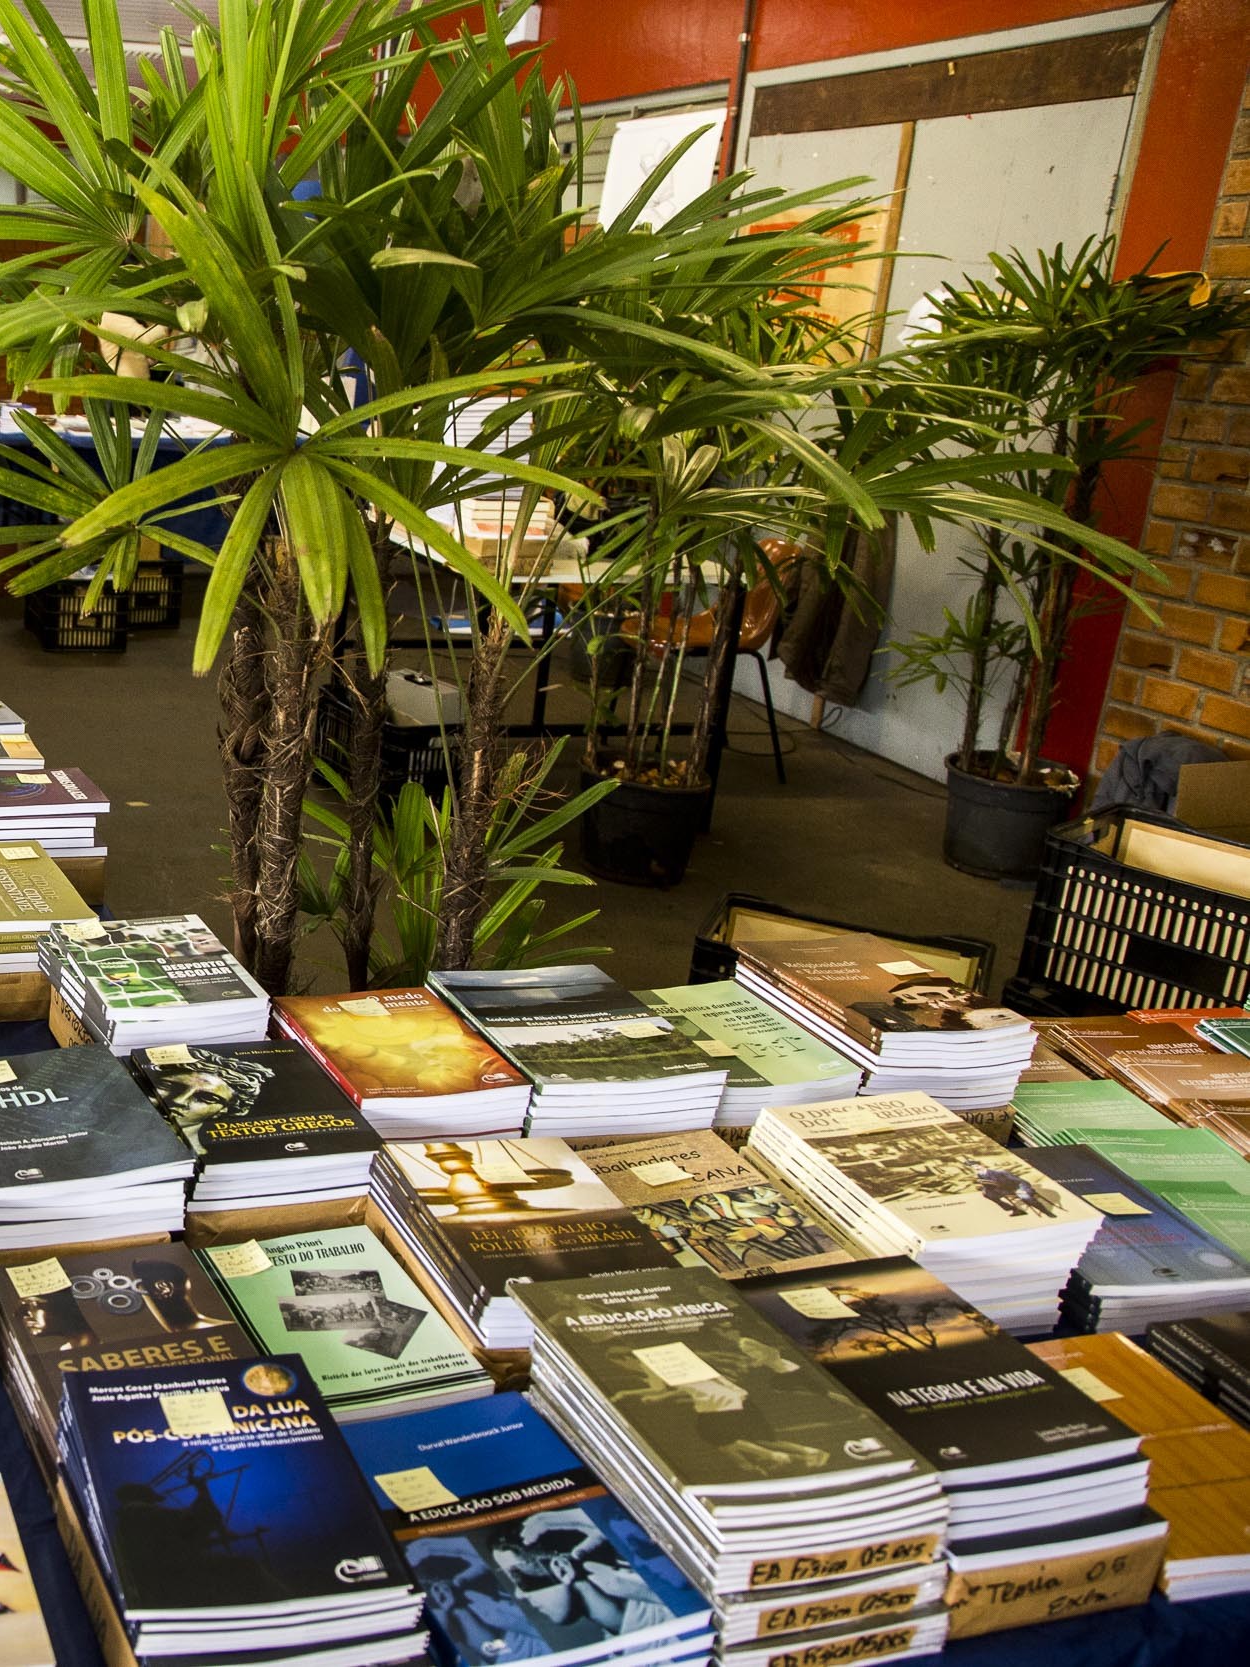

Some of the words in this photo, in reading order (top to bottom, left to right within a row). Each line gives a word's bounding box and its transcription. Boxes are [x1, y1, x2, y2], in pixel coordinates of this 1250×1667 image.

[23, 888, 53, 913] CIDADE
[157, 957, 166, 965] O
[164, 960, 226, 972] DESPORTO
[167, 966, 232, 979] ESCOLAR
[383, 991, 423, 1001] medo
[322, 1005, 341, 1014] do
[384, 997, 430, 1008] mento
[790, 1111, 805, 1120] O
[206, 1123, 277, 1139] TEXTOS
[280, 1118, 355, 1133] GREGOS
[590, 1150, 701, 1175] abalhadores
[692, 1165, 751, 1182] CANA
[507, 1221, 607, 1239] TRABALHO
[296, 1238, 324, 1249] Priori
[469, 1239, 558, 1253] POLÍTICA
[578, 1230, 642, 1243] BRASIL
[300, 1250, 315, 1263] DO
[317, 1242, 365, 1261] TRABALHO
[565, 1316, 581, 1328] A
[581, 1306, 672, 1327] EDUCAÇÃO
[675, 1300, 729, 1316] FÍSICA
[57, 1339, 201, 1372] SABERES
[207, 1335, 231, 1352] E
[887, 1389, 919, 1407] NA
[909, 1382, 972, 1404] TEORIA
[979, 1375, 1007, 1394] NA
[999, 1369, 1046, 1389] VIDA
[231, 1405, 267, 1418] DA
[268, 1400, 310, 1415] LUA
[409, 1513, 420, 1522] A
[421, 1498, 493, 1521] EDUCAÇÃO
[494, 1491, 521, 1506] SOB
[522, 1477, 575, 1497] MEDIDA
